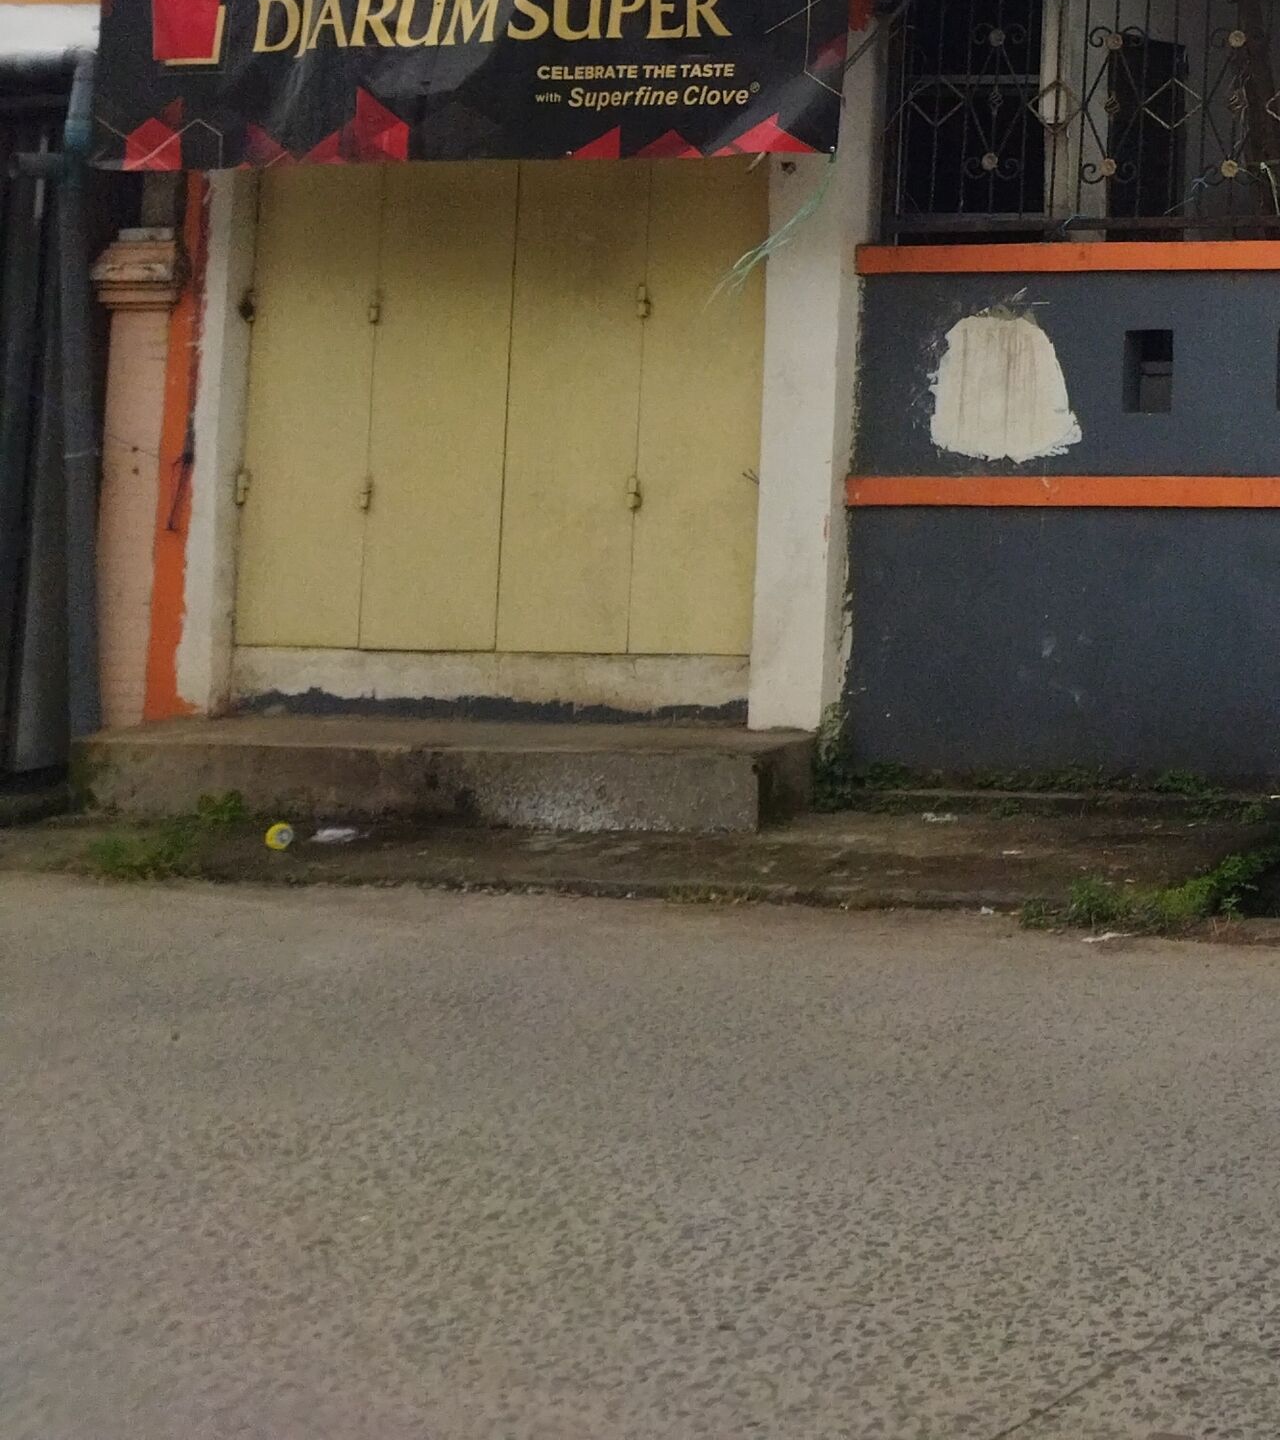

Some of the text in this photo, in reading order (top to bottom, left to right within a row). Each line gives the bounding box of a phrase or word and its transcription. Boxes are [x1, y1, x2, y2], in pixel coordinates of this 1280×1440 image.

[537, 63, 735, 80] CELEBRATE THE TASTE
[535, 91, 562, 103] with
[568, 86, 679, 111] Superfine
